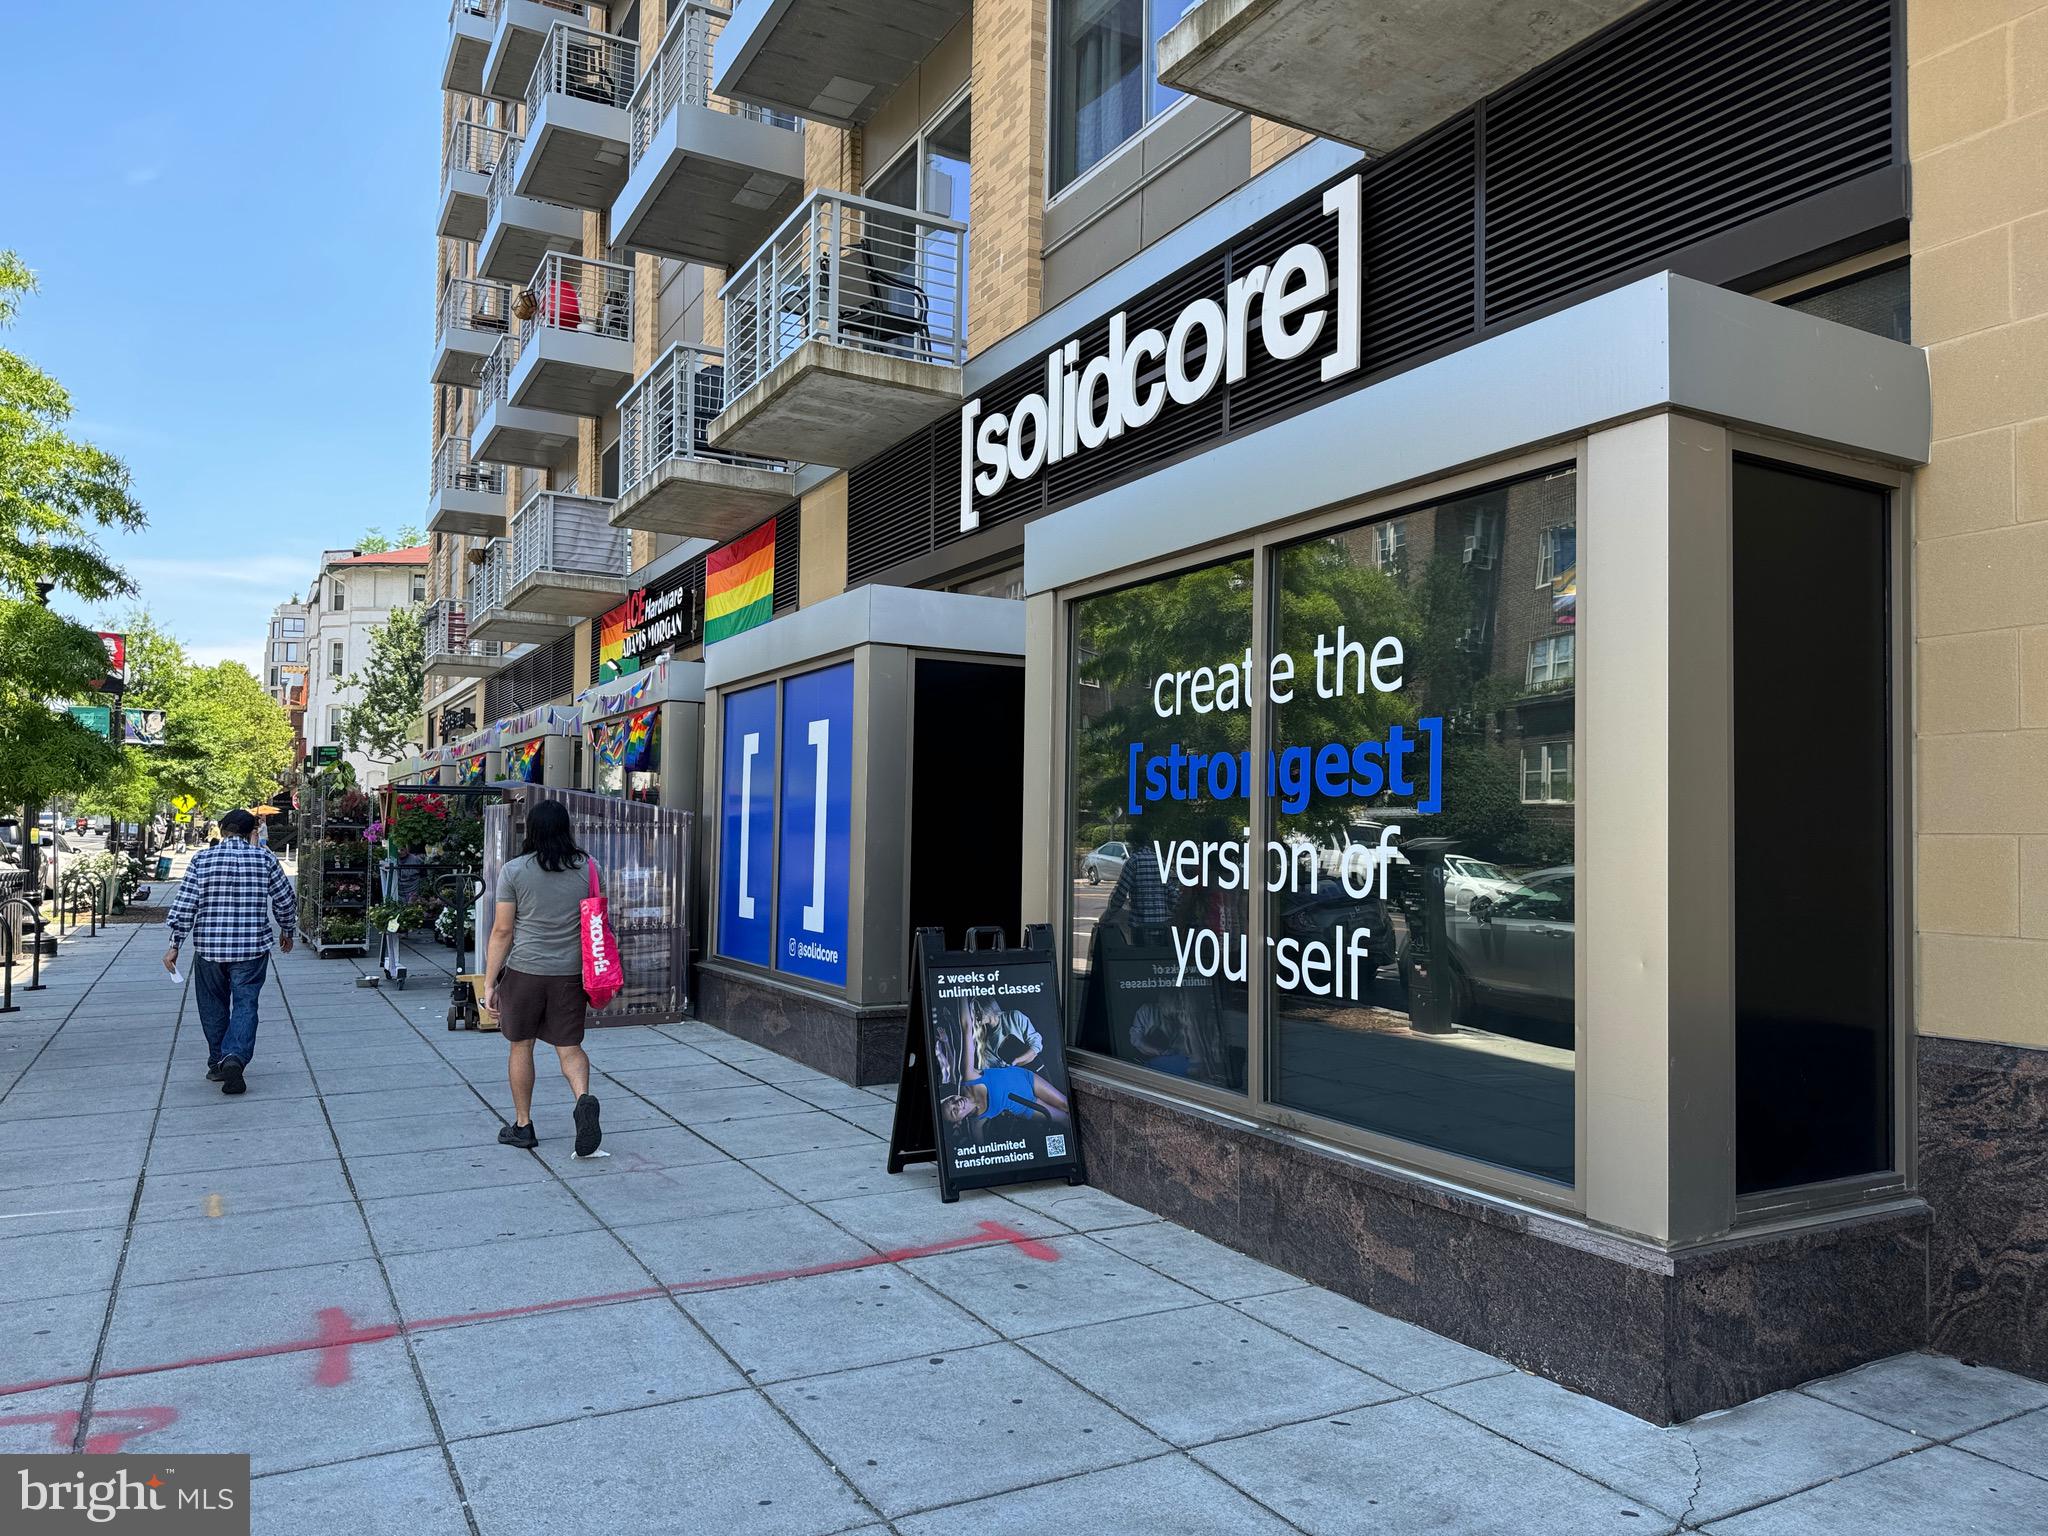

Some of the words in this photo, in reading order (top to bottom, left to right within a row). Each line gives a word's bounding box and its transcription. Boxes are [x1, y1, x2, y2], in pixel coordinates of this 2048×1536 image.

[960, 173, 1362, 533] [solidcore]
[624, 587, 646, 632] ACE
[645, 586, 684, 621] Hardware
[1154, 647, 1295, 718] create
[1314, 625, 1404, 700] the
[1341, 825, 1401, 900] of
[797, 942, 838, 964] @solidcore
[1171, 925, 1371, 1001] youself
[938, 974, 945, 984] 2
[947, 971, 985, 984] weeks
[987, 970, 1000, 982] of
[938, 984, 996, 998] unlimited
[954, 1151, 1035, 1169] transformations
[978, 1138, 1026, 1153] unlimited
